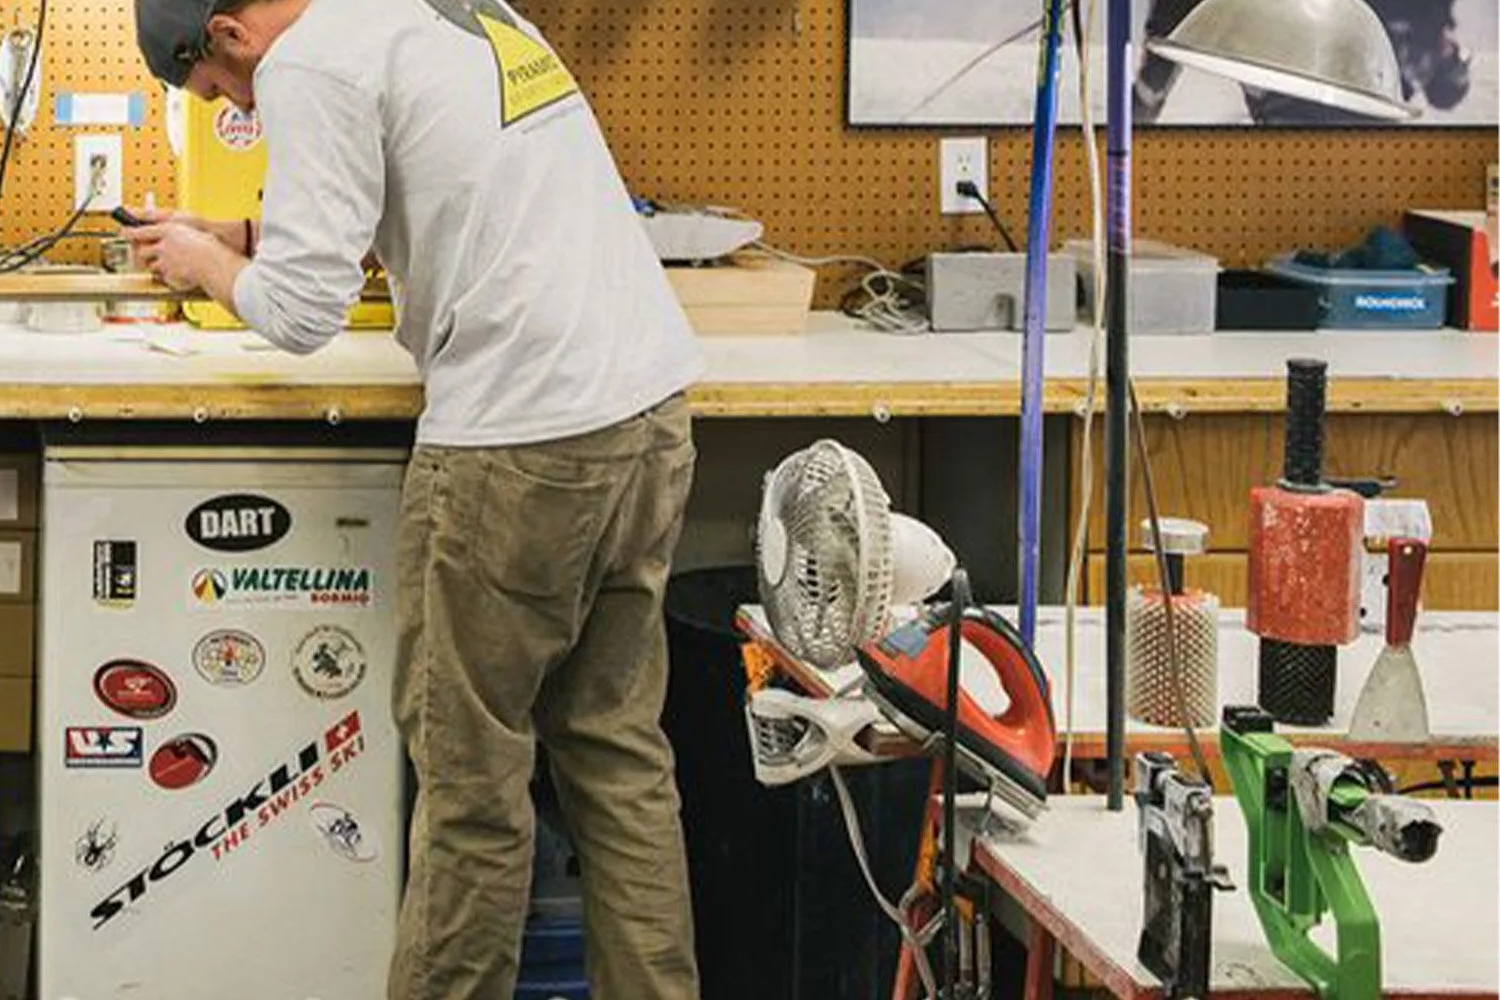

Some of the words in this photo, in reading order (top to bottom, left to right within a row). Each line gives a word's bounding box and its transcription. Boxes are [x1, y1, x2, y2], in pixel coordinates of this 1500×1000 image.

[199, 506, 277, 540] DART
[230, 568, 370, 592] VALTELLINA
[89, 741, 320, 931] STÖCKLI
[211, 822, 252, 862] THE
[258, 769, 325, 829] SWISS
[330, 736, 366, 772] SKI
